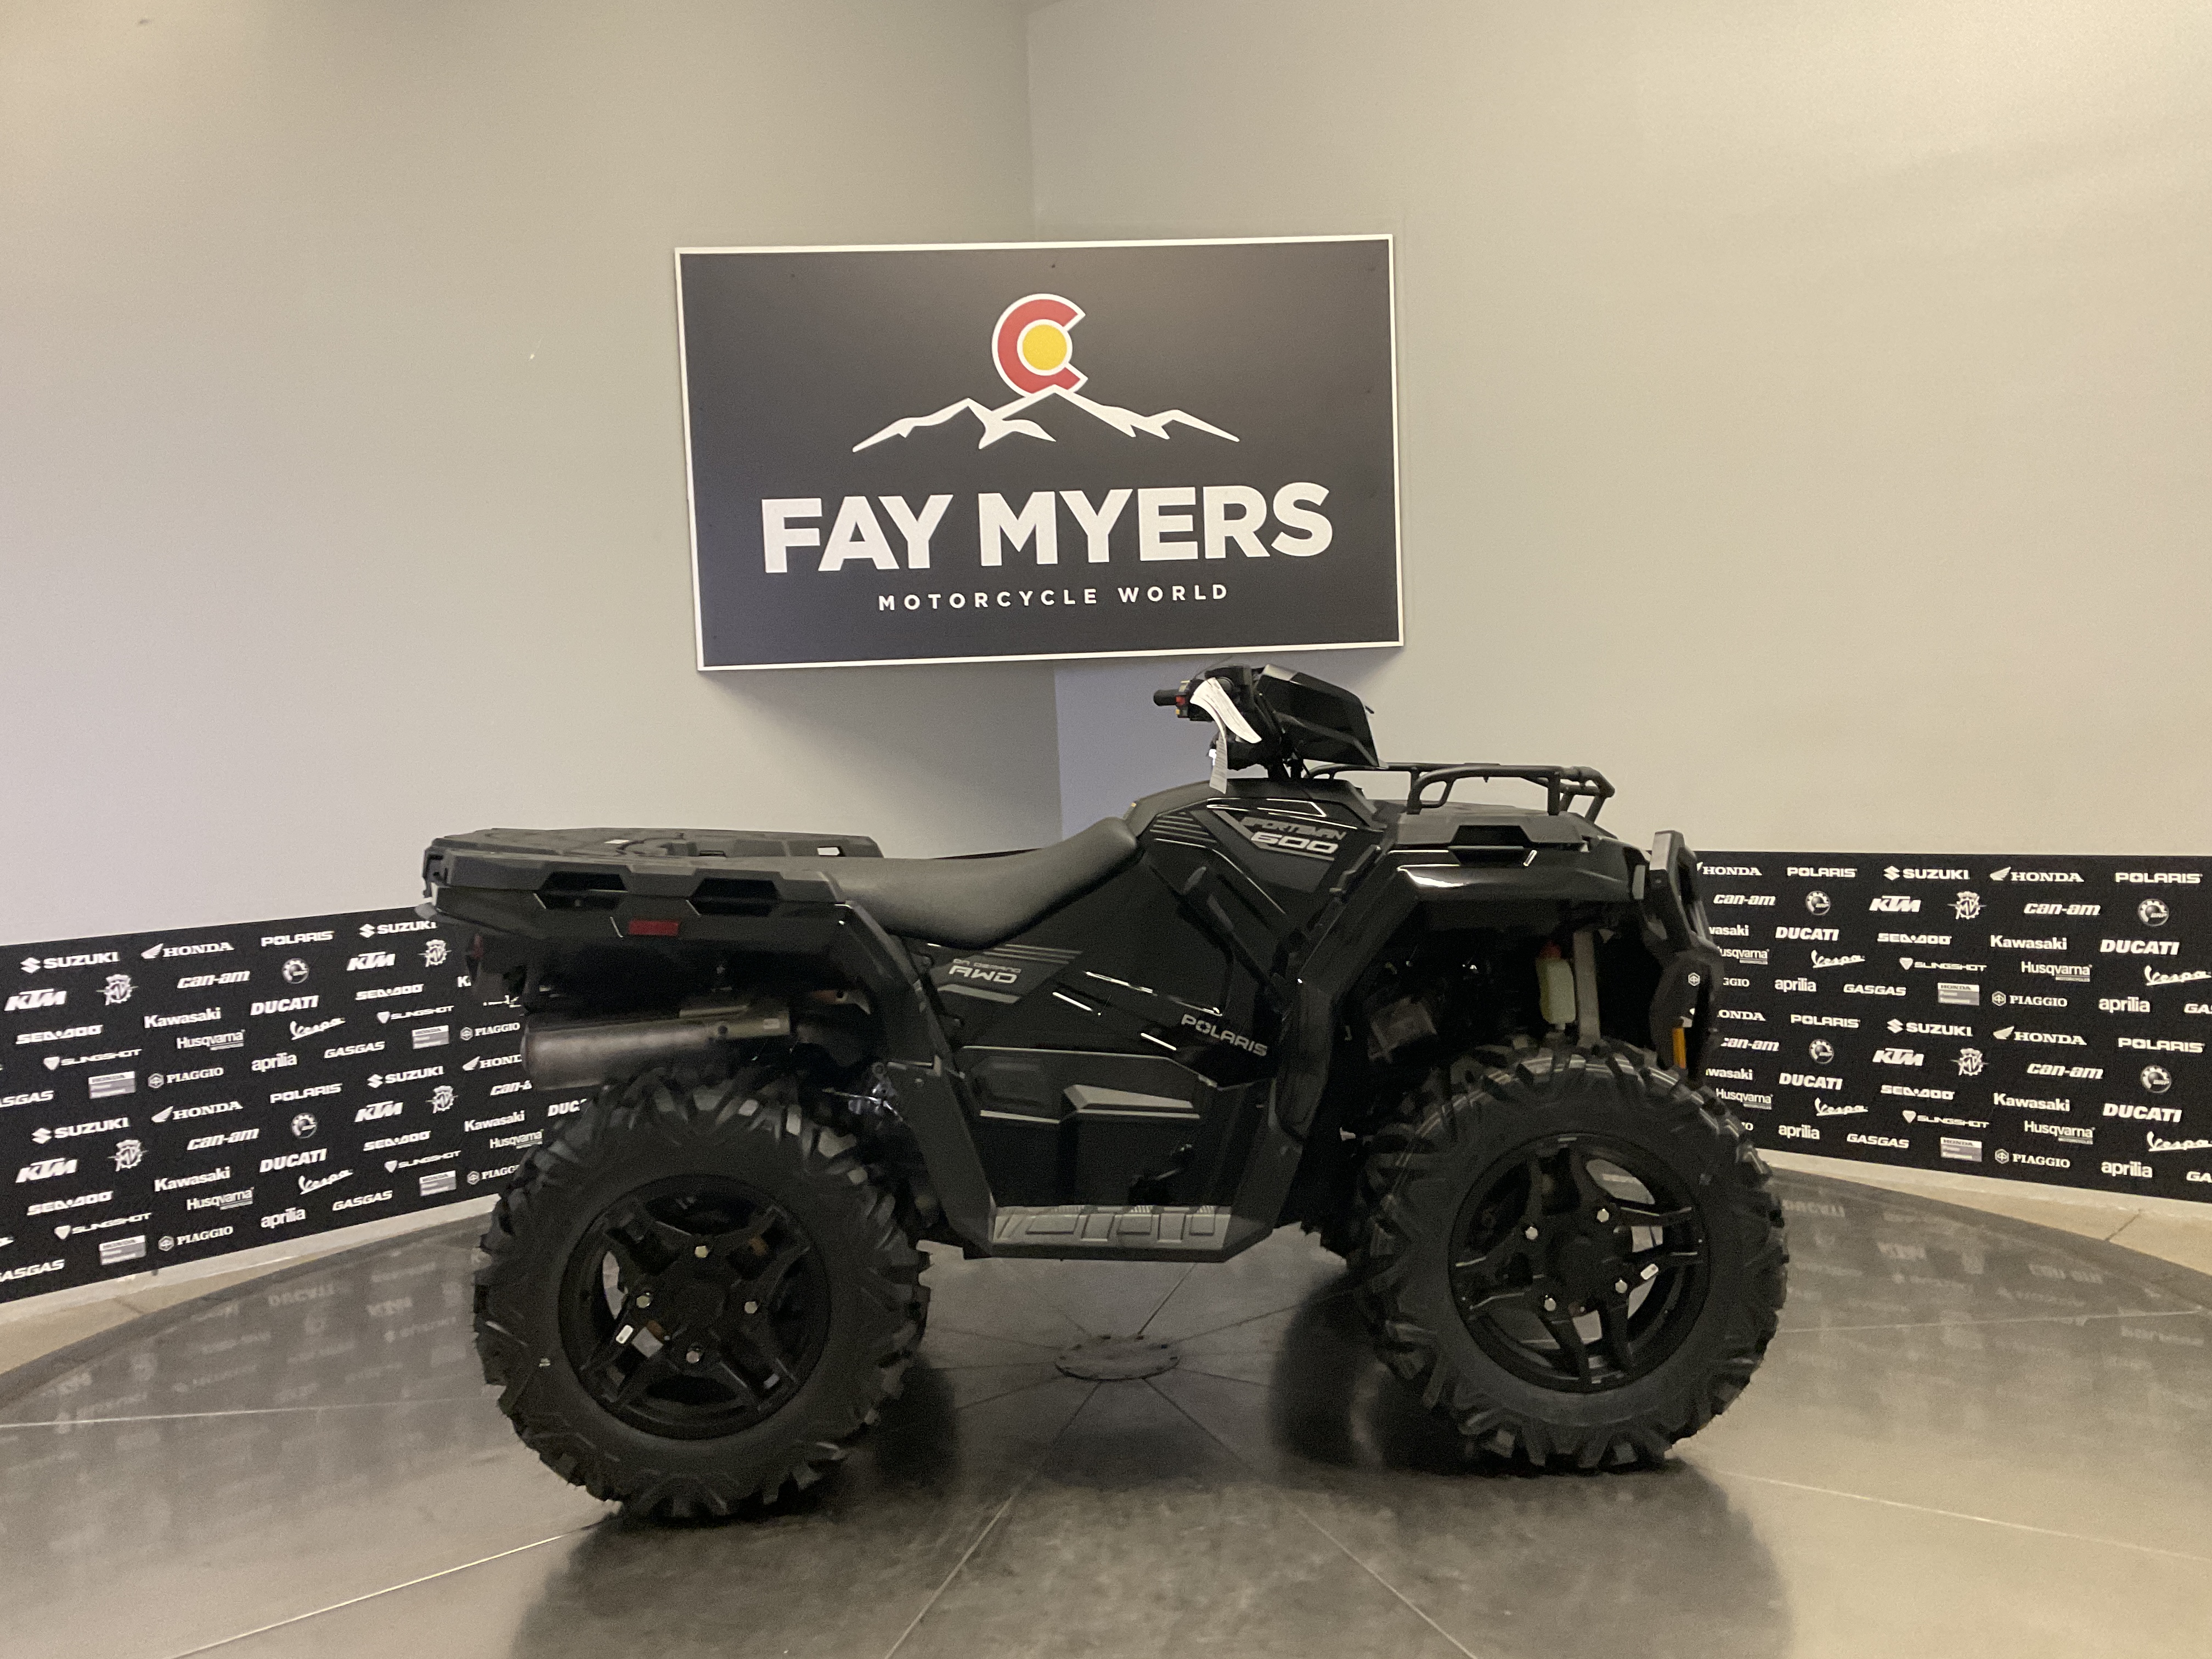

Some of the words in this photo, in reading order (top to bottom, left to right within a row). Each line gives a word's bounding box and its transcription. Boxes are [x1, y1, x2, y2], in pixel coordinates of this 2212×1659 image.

[761, 494, 953, 574] FAY
[978, 482, 1334, 567] MYERS
[878, 587, 1098, 611] MOTORCYCLE
[1117, 583, 1228, 604] WORLD
[1251, 831, 1339, 854] 600
[1701, 865, 1762, 876] HONDA
[1787, 867, 1857, 877] POLARIS
[1903, 868, 1970, 879] SUZUKI
[2011, 872, 2084, 882] HONDA
[2115, 872, 2203, 883] POLARIS
[1713, 894, 1775, 905] can-am
[1869, 895, 1921, 912] KTM
[2024, 903, 2101, 916] can-am
[261, 931, 334, 946] POLARIS
[1775, 927, 1839, 941] DUCATI
[1990, 935, 2067, 950] Kawasaki
[161, 942, 235, 957] HONDA
[1718, 946, 1770, 961] usqvarna
[2100, 939, 2180, 955] DUCATI
[43, 952, 120, 969] SUZUKI
[347, 951, 396, 970] KTM
[1811, 950, 1865, 968] Vespa
[1914, 962, 1987, 971] SLINGSHOT
[949, 965, 1017, 984] AWD
[2021, 961, 2092, 977] Husqvarna
[2145, 965, 2211, 986] Vespa
[177, 971, 250, 989] can-am
[1775, 978, 1816, 992] aprilia
[1843, 984, 1906, 996] GASGAS
[4, 988, 67, 1011] KTM
[250, 995, 319, 1015] DUCATI
[2010, 995, 2067, 1007] PIAGGIO
[2098, 996, 2150, 1013] aprilia
[144, 1007, 221, 1028] Kawasaki
[390, 1005, 455, 1020] SLINGSHOT
[1718, 1009, 1766, 1022] ONDA
[1791, 1014, 1860, 1028] POLARIS
[290, 1018, 346, 1040] Vespa
[475, 1023, 520, 1036] PIAGGIO
[1181, 1014, 1268, 1057] POLARIS
[1906, 1023, 1973, 1037] SUZUKI
[177, 1030, 245, 1049] Husqvarna
[2014, 1031, 2087, 1045] HONDA
[2118, 1037, 2205, 1053] POLARIS
[61, 1049, 142, 1066] SLINGSHOT
[324, 1041, 385, 1058] GASGAS
[1872, 1048, 1924, 1066] KTM
[251, 1052, 297, 1072] aprilia
[479, 1054, 522, 1069] HOND
[166, 1068, 224, 1083] PIAGGIO
[385, 1066, 444, 1084] SUZUKI
[1706, 1068, 1753, 1081] wasaki
[2027, 1063, 2103, 1079] can-am
[1779, 1073, 1843, 1090] DUCATI
[0, 1091, 54, 1108] SGAS
[270, 1083, 342, 1103] POLARIS
[1716, 1088, 1773, 1104] Husqvarna
[171, 1101, 243, 1120] HONDA
[548, 1101, 580, 1116] DUC
[1815, 1098, 1868, 1116] Vespa
[1993, 1093, 2070, 1111] Kawasaki
[354, 1101, 403, 1122] KTM
[2103, 1103, 2182, 1122] DUCATI
[54, 1118, 132, 1141] SUZUKI
[465, 1110, 524, 1132] Kawasaki
[1917, 1115, 1990, 1128] SLINGSHOT
[2024, 1120, 2095, 1139] Husqvarna
[187, 1128, 259, 1150] can-am
[489, 1130, 543, 1149] Husqvarna
[1779, 1124, 1820, 1139] aprilia
[1847, 1133, 1909, 1148] GASGAS
[2146, 1131, 2212, 1152] Vespa
[259, 1148, 327, 1172] DUCATI
[397, 1150, 461, 1169] SLINGSHOT
[2012, 1154, 2070, 1168] PIAGGIO
[15, 1158, 77, 1183] KTM
[482, 1165, 520, 1180] PIAGG
[2101, 1161, 2152, 1178] aprilia
[154, 1166, 230, 1192] Kawasaki
[298, 1170, 353, 1195] Vespa
[187, 1187, 253, 1211] Husqvarna
[332, 1190, 392, 1211] GASGAS
[71, 1212, 153, 1235] SLINGSHOT
[261, 1207, 306, 1228] aprilia
[177, 1226, 233, 1245] PIAGGIO
[0, 1259, 65, 1282] ASGAS
